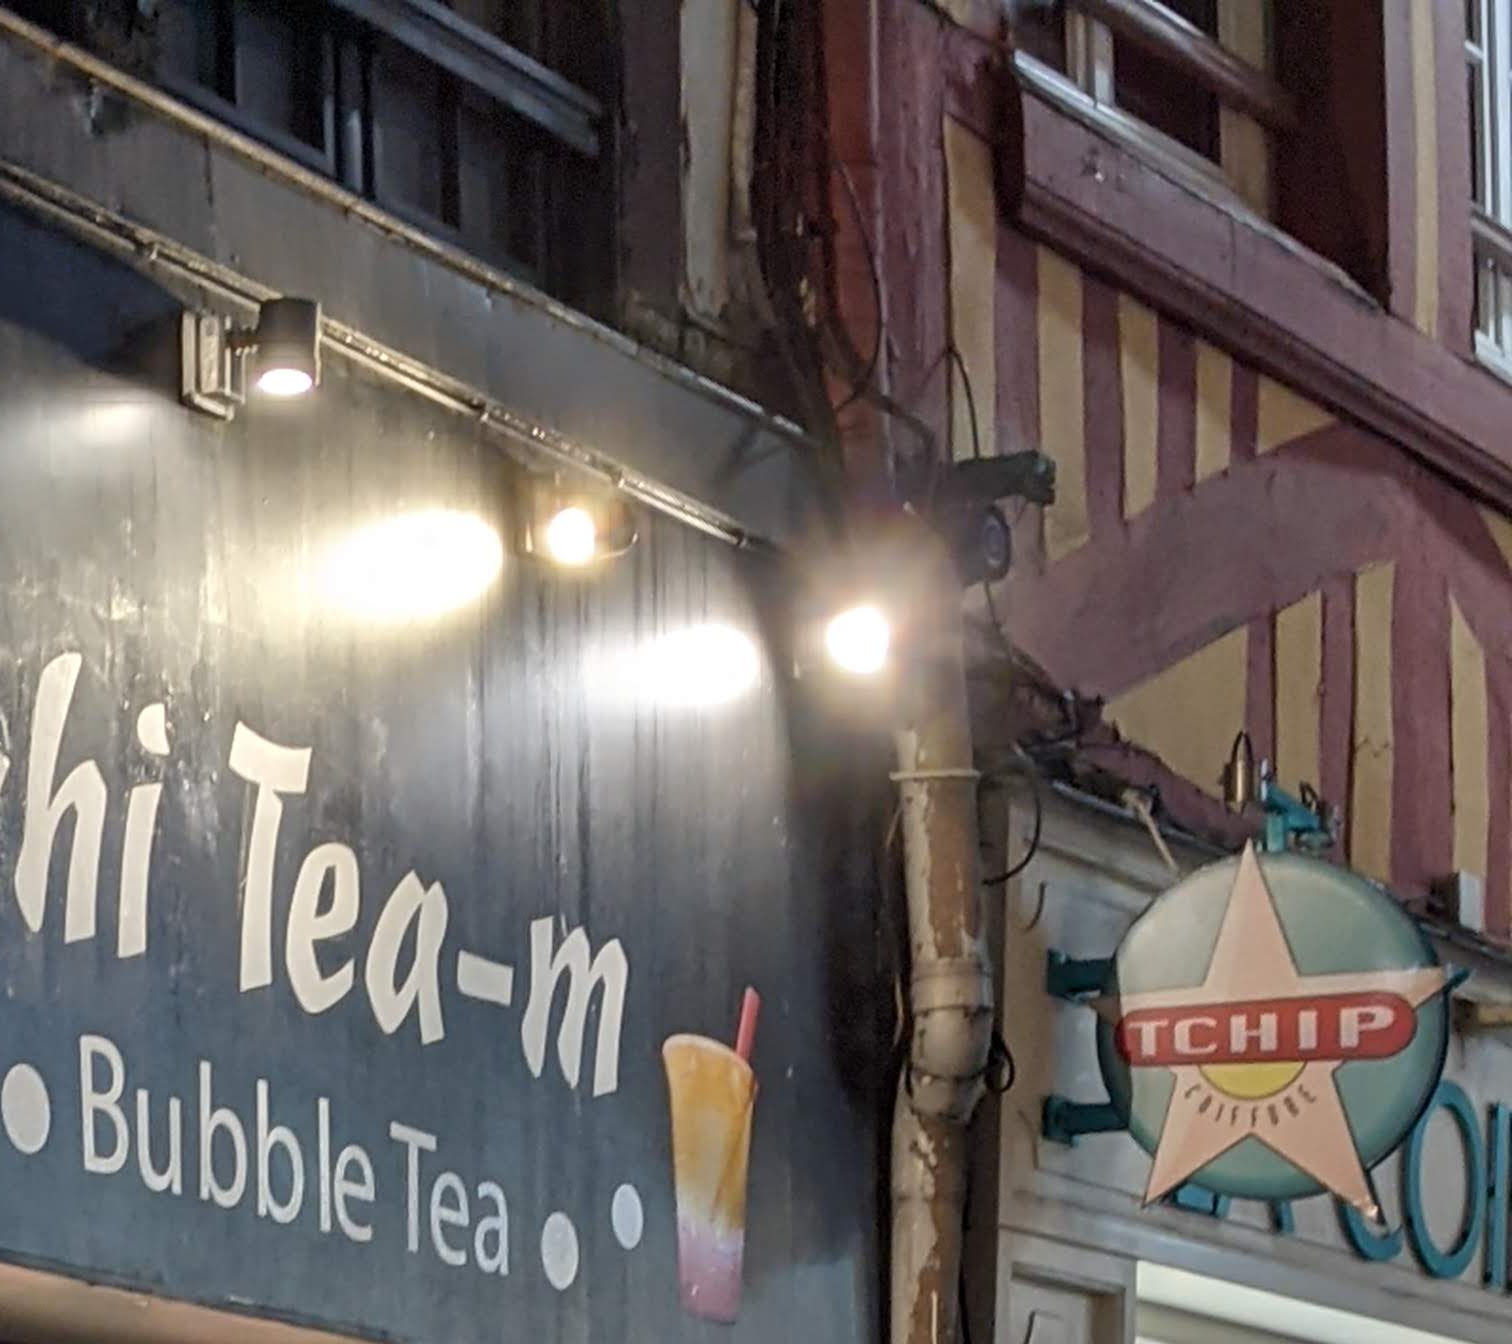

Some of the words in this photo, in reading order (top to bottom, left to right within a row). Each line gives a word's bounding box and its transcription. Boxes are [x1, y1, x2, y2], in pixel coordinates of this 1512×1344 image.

[229, 722, 630, 1098] Tea-m
[1127, 1005, 1396, 1057] TCHIP
[78, 1034, 376, 1242] Bubble
[389, 1121, 510, 1276] Tea
